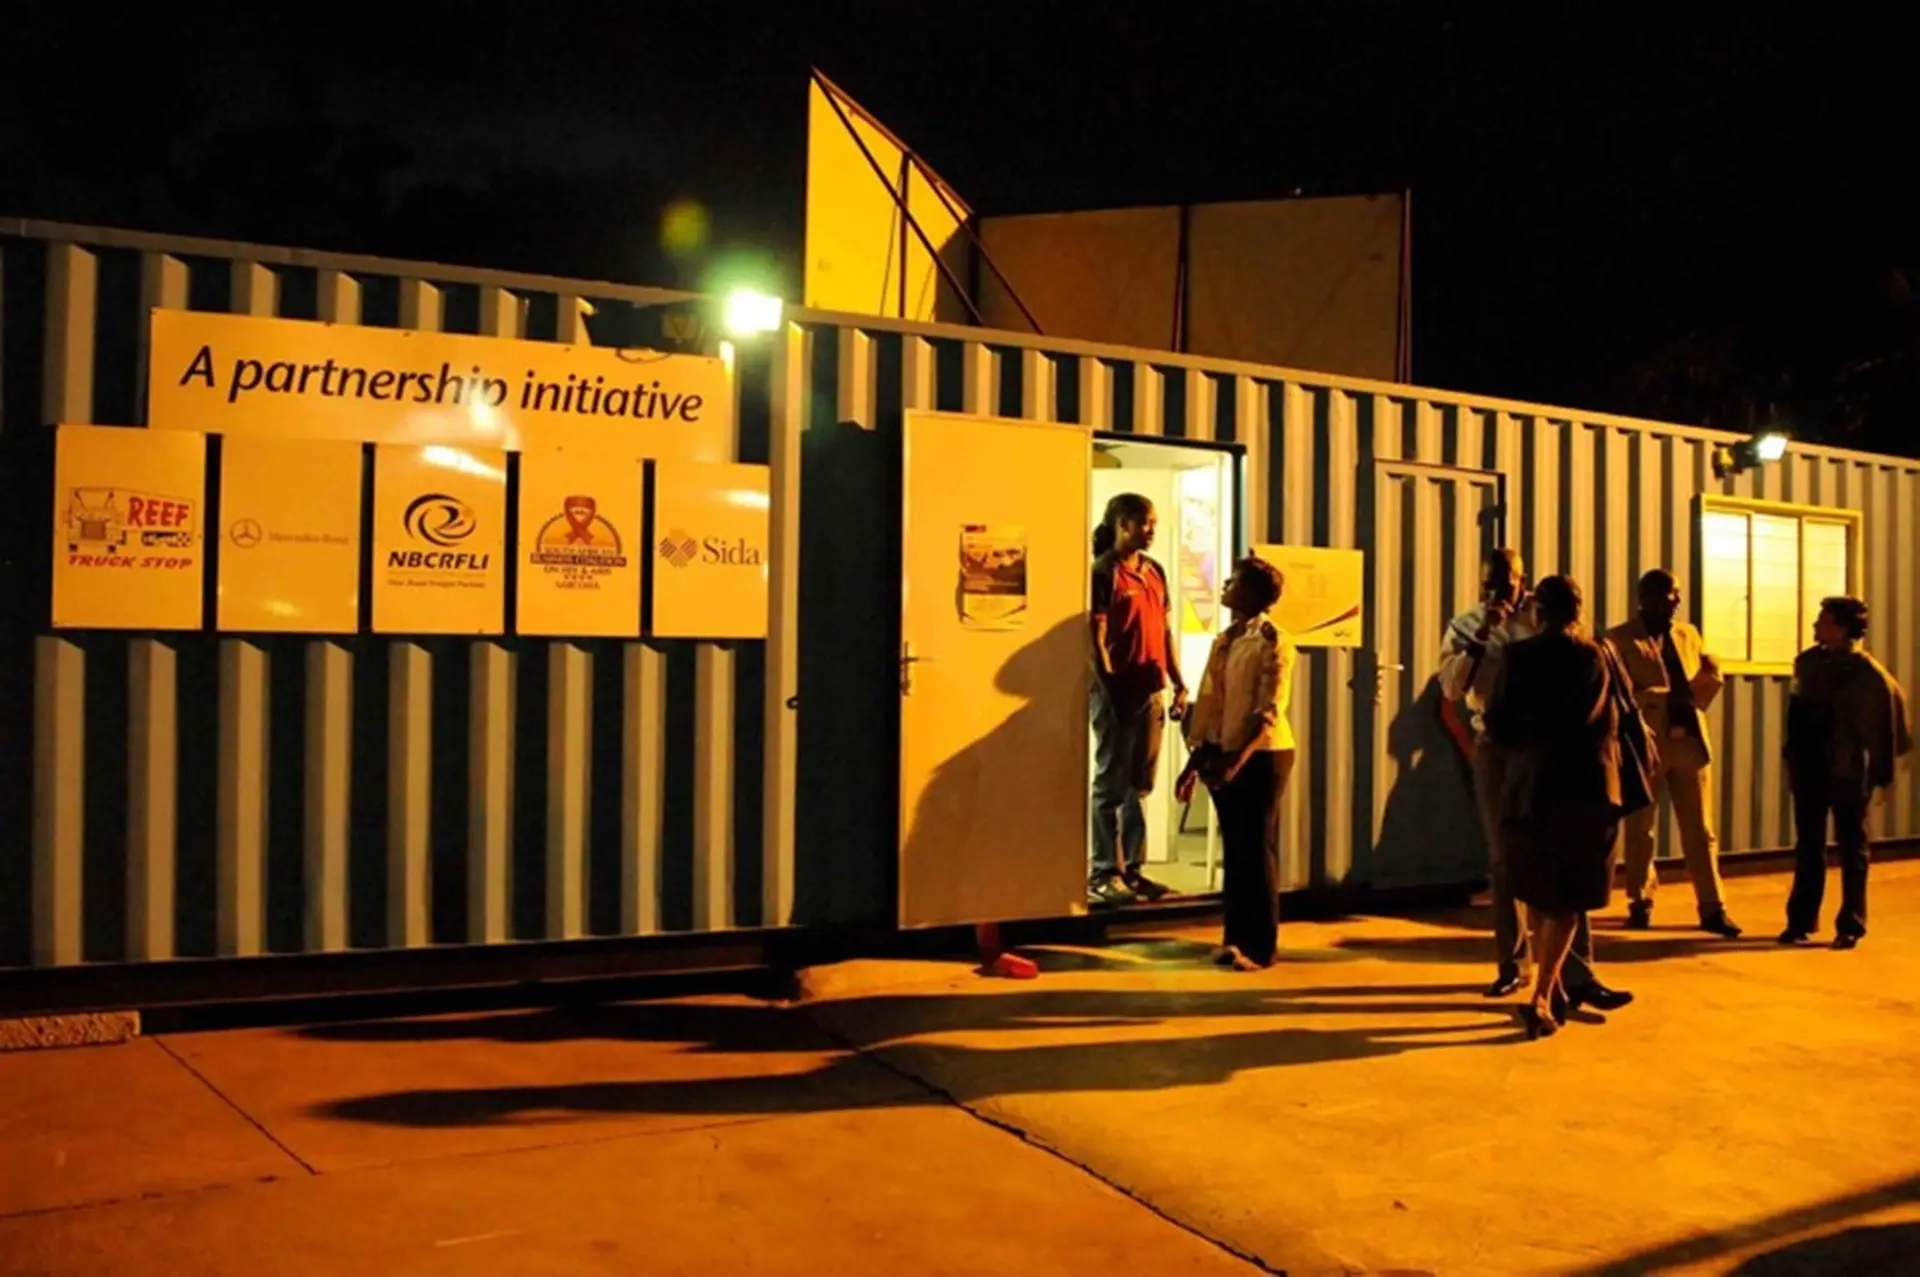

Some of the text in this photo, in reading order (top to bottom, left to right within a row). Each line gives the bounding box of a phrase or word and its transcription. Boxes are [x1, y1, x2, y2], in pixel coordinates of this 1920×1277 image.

[178, 344, 704, 423] A partnership initiative
[127, 496, 190, 528] REEF
[68, 554, 193, 570] TRUCK STOP
[387, 551, 490, 571] NBCRFLI
[702, 535, 761, 566] Sida
